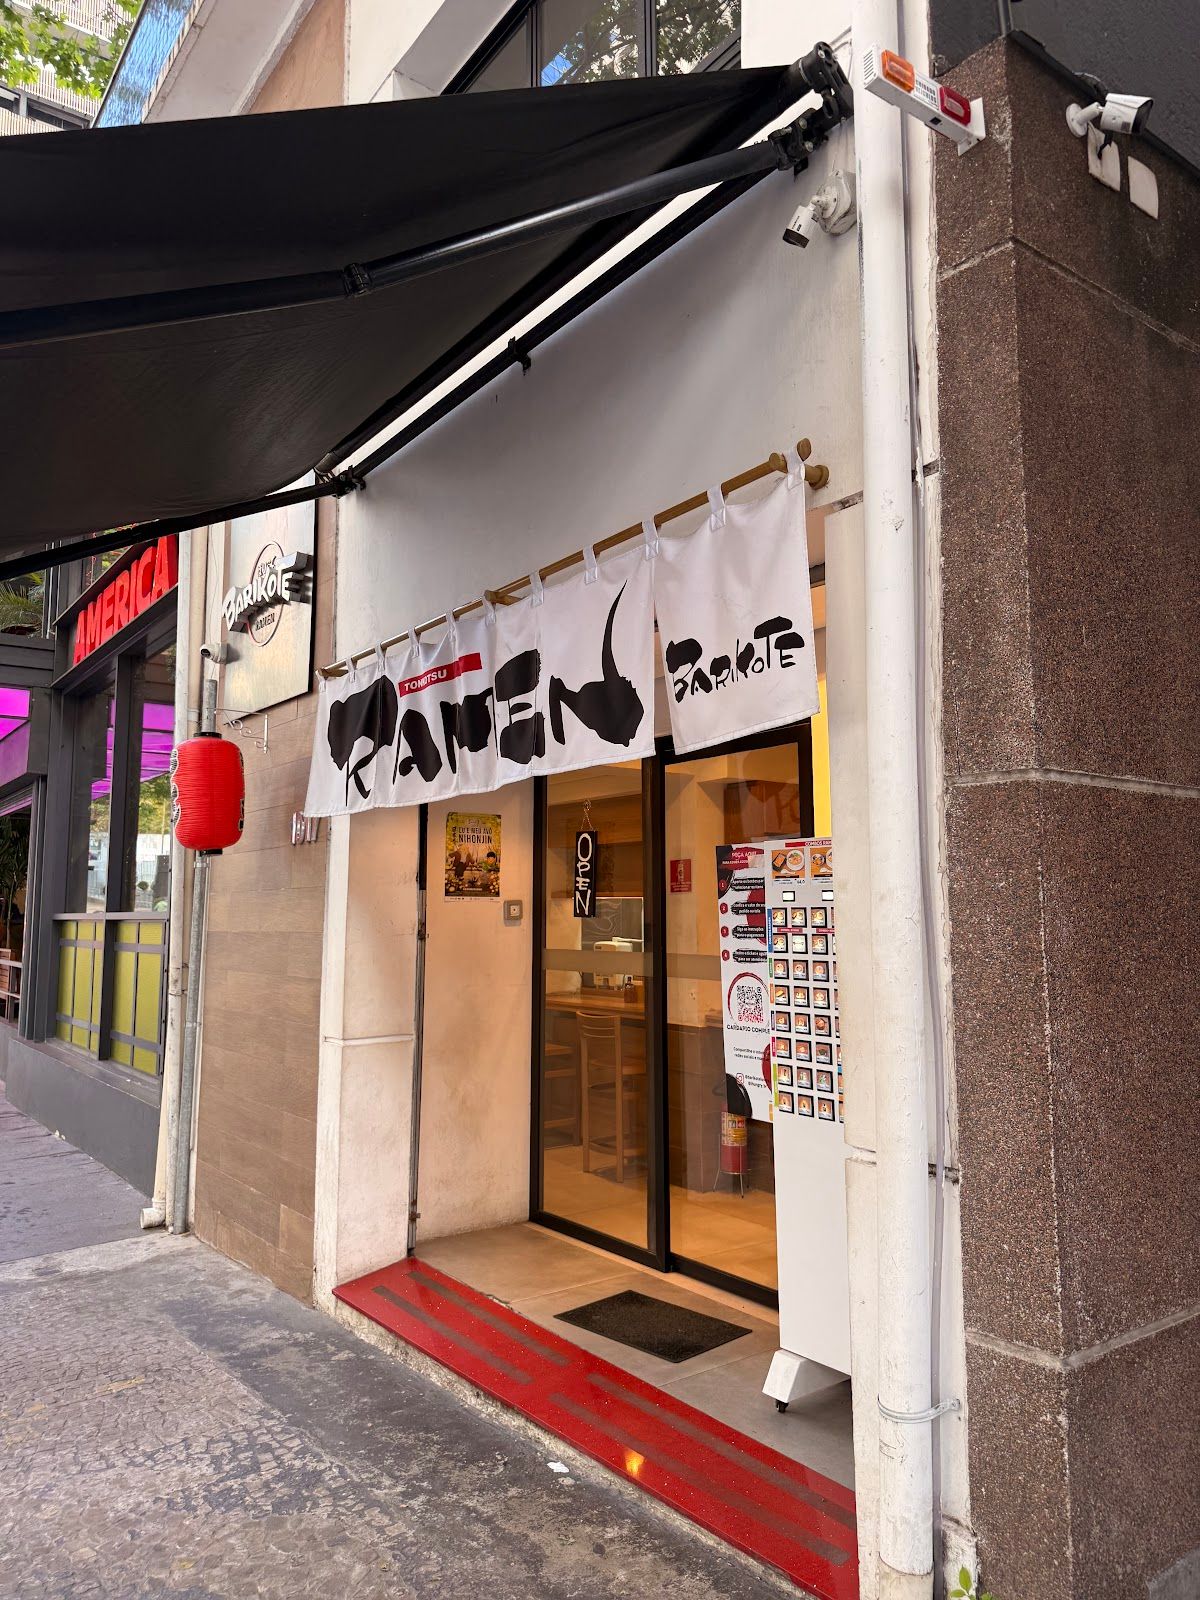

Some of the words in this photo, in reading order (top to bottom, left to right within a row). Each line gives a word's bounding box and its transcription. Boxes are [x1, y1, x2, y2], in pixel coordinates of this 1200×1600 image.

[73, 534, 177, 666] AMERICA
[222, 552, 299, 631] BARIKOTE
[327, 579, 645, 807] RAMEN
[665, 616, 805, 703] BARIKOTE
[458, 834, 492, 844] NIHONJIN
[575, 833, 592, 916] OPEN
